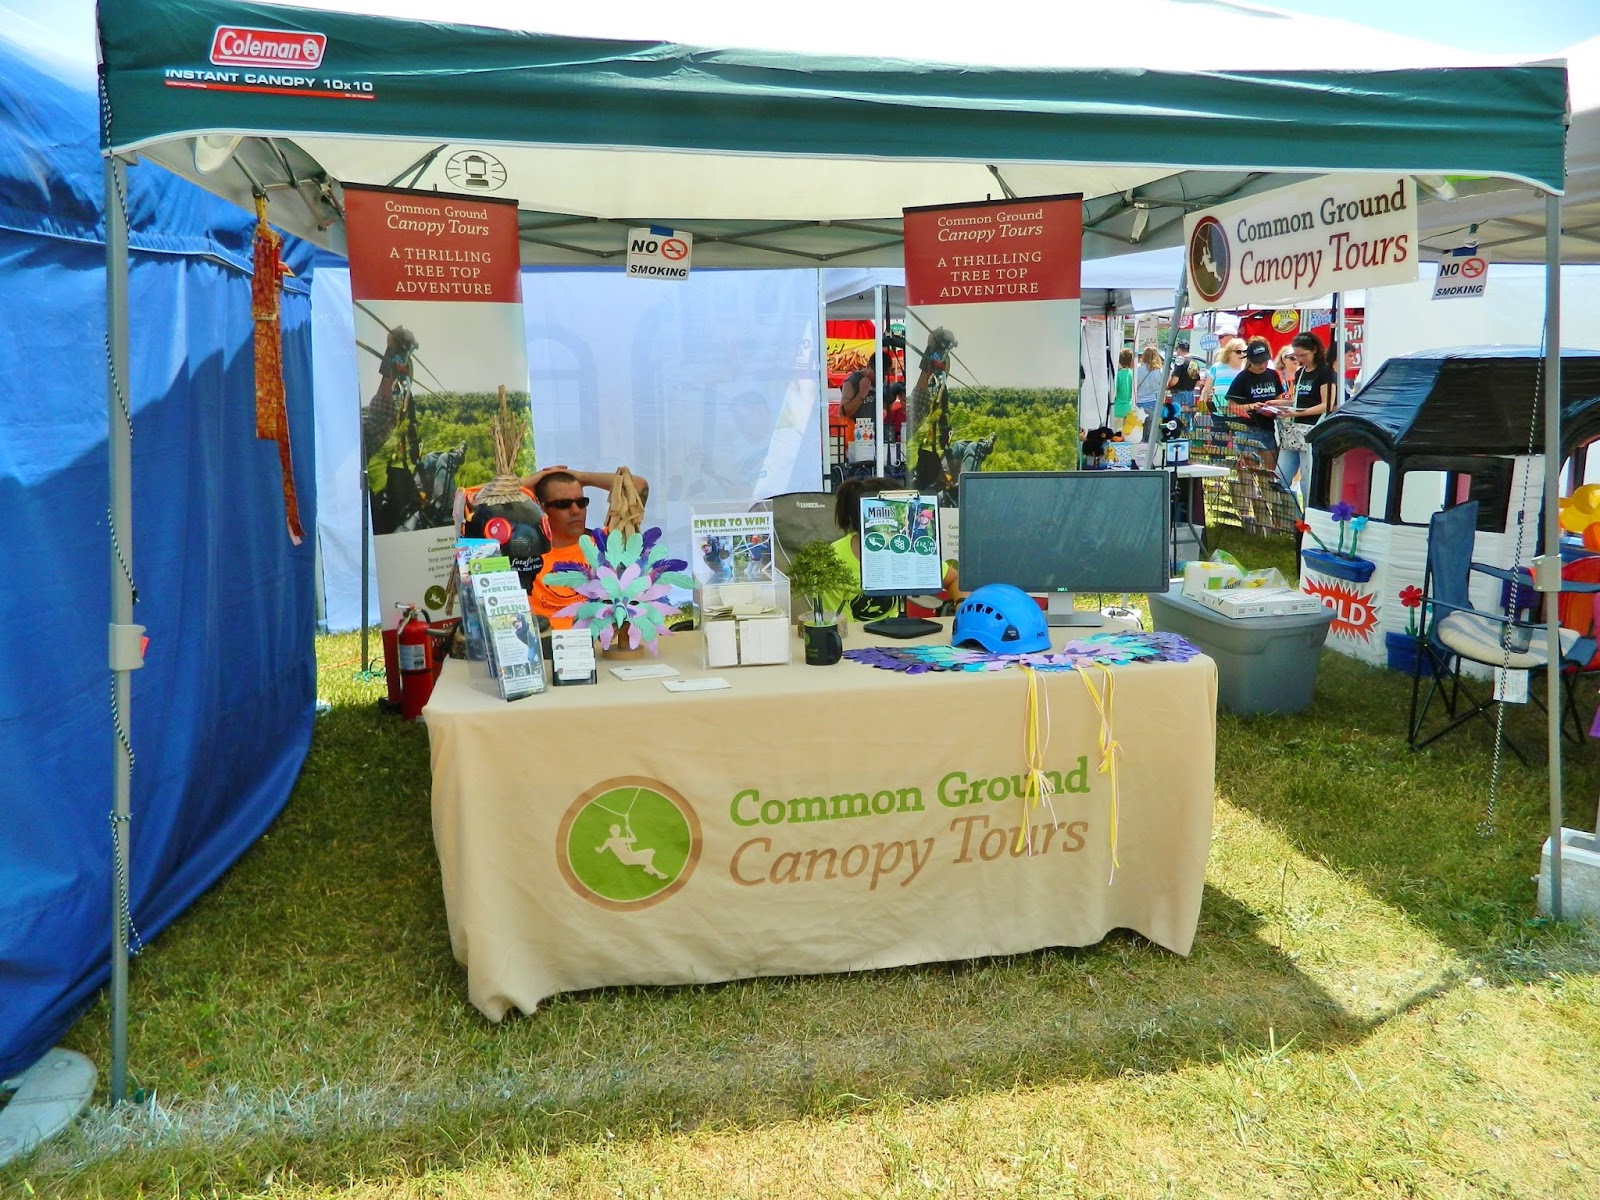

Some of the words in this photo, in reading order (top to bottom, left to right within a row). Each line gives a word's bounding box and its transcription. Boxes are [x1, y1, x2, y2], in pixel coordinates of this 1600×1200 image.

[219, 31, 301, 59] Coleman
[165, 69, 239, 83] INSTANT
[244, 73, 315, 87] CANOPY
[323, 79, 373, 91] 10x10
[385, 201, 440, 215] Common
[444, 206, 488, 220] Ground
[938, 215, 992, 227] Common
[996, 209, 1043, 222] Ground
[1237, 211, 1314, 244] Common
[1320, 179, 1406, 225] Ground
[387, 215, 445, 236] Canopy
[448, 219, 489, 236] Tours
[938, 228, 995, 243] Canopy
[999, 224, 1043, 238] Tours
[631, 239, 658, 253] NO
[389, 247, 400, 259] A
[404, 248, 491, 263] THRILLING
[937, 257, 947, 267] A
[952, 251, 1042, 267] THRILLING
[1240, 249, 1323, 290] Canopy
[1329, 232, 1408, 272] Tours
[404, 264, 445, 277] TREE
[449, 266, 480, 278] TOP
[630, 264, 687, 277] SMOKING
[951, 270, 990, 281] TREE
[996, 268, 1028, 279] TOP
[1439, 263, 1460, 277] NO
[395, 281, 492, 294] ADVENTURE
[940, 283, 1039, 297] ADVENTURE
[1435, 285, 1483, 296] SMOKING
[694, 519, 726, 528] ENTER
[728, 518, 742, 527] TO
[745, 516, 770, 526] WIN!
[1310, 592, 1366, 626] OLD
[730, 786, 925, 827] Common
[937, 755, 1090, 808] Ground
[729, 837, 935, 891] Canopy
[950, 815, 1089, 864] Tours
